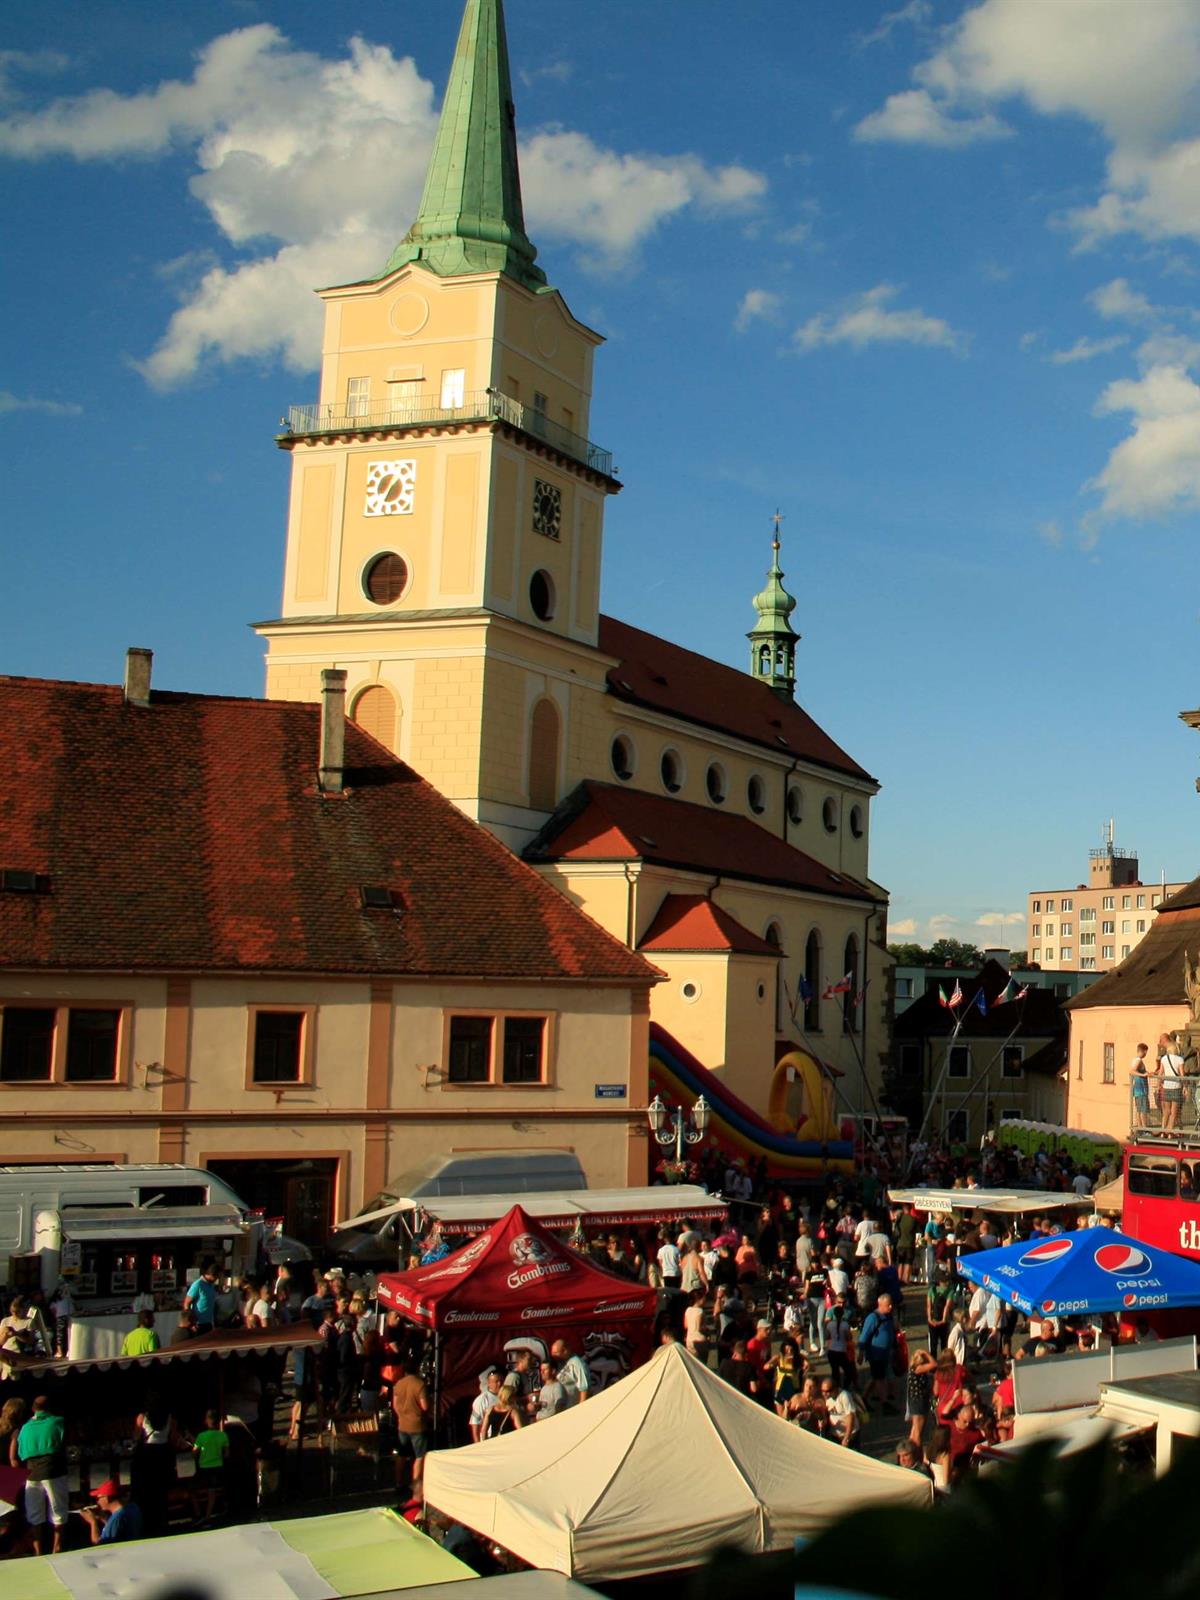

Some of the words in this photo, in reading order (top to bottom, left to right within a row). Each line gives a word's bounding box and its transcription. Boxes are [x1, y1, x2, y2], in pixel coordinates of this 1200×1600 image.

[507, 1262, 571, 1289] Gambrinus
[1116, 1278, 1163, 1290] pepsi
[1058, 1299, 1089, 1312] pepsi
[1138, 1293, 1168, 1306] pepsi
[444, 1309, 500, 1324] Gambrinus
